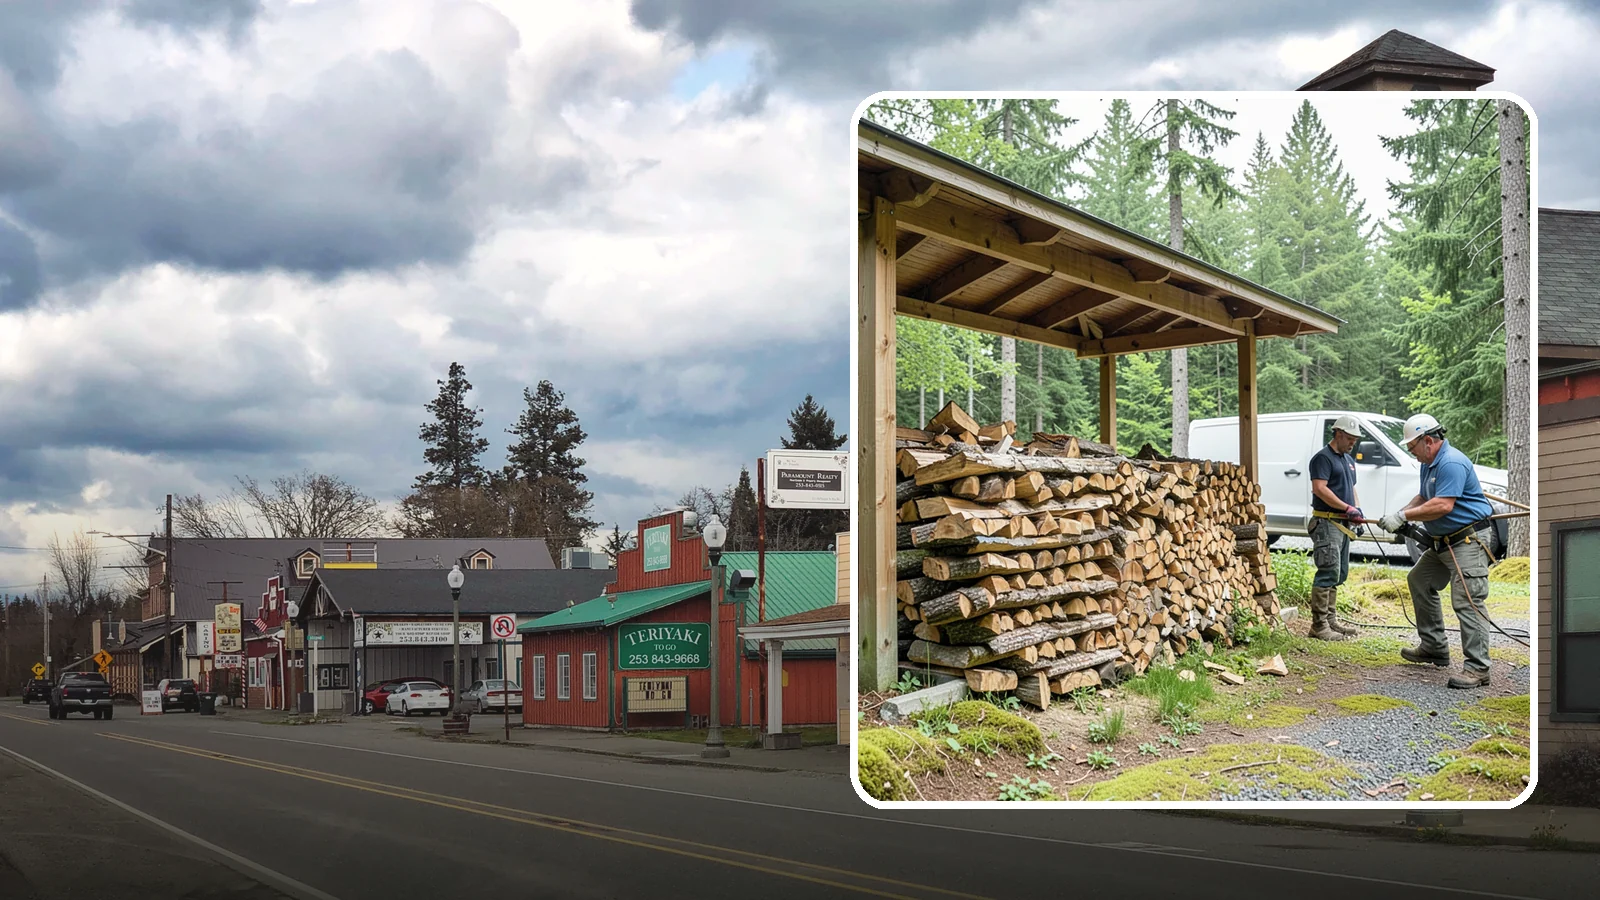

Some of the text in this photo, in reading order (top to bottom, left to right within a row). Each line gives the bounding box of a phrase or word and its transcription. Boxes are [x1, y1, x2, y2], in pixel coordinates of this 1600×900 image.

[646, 530, 668, 549] TERIYAKI
[624, 627, 702, 646] TERIYAKI
[628, 654, 700, 664] 253 843-9668
[639, 681, 672, 690] TERIYAKI
